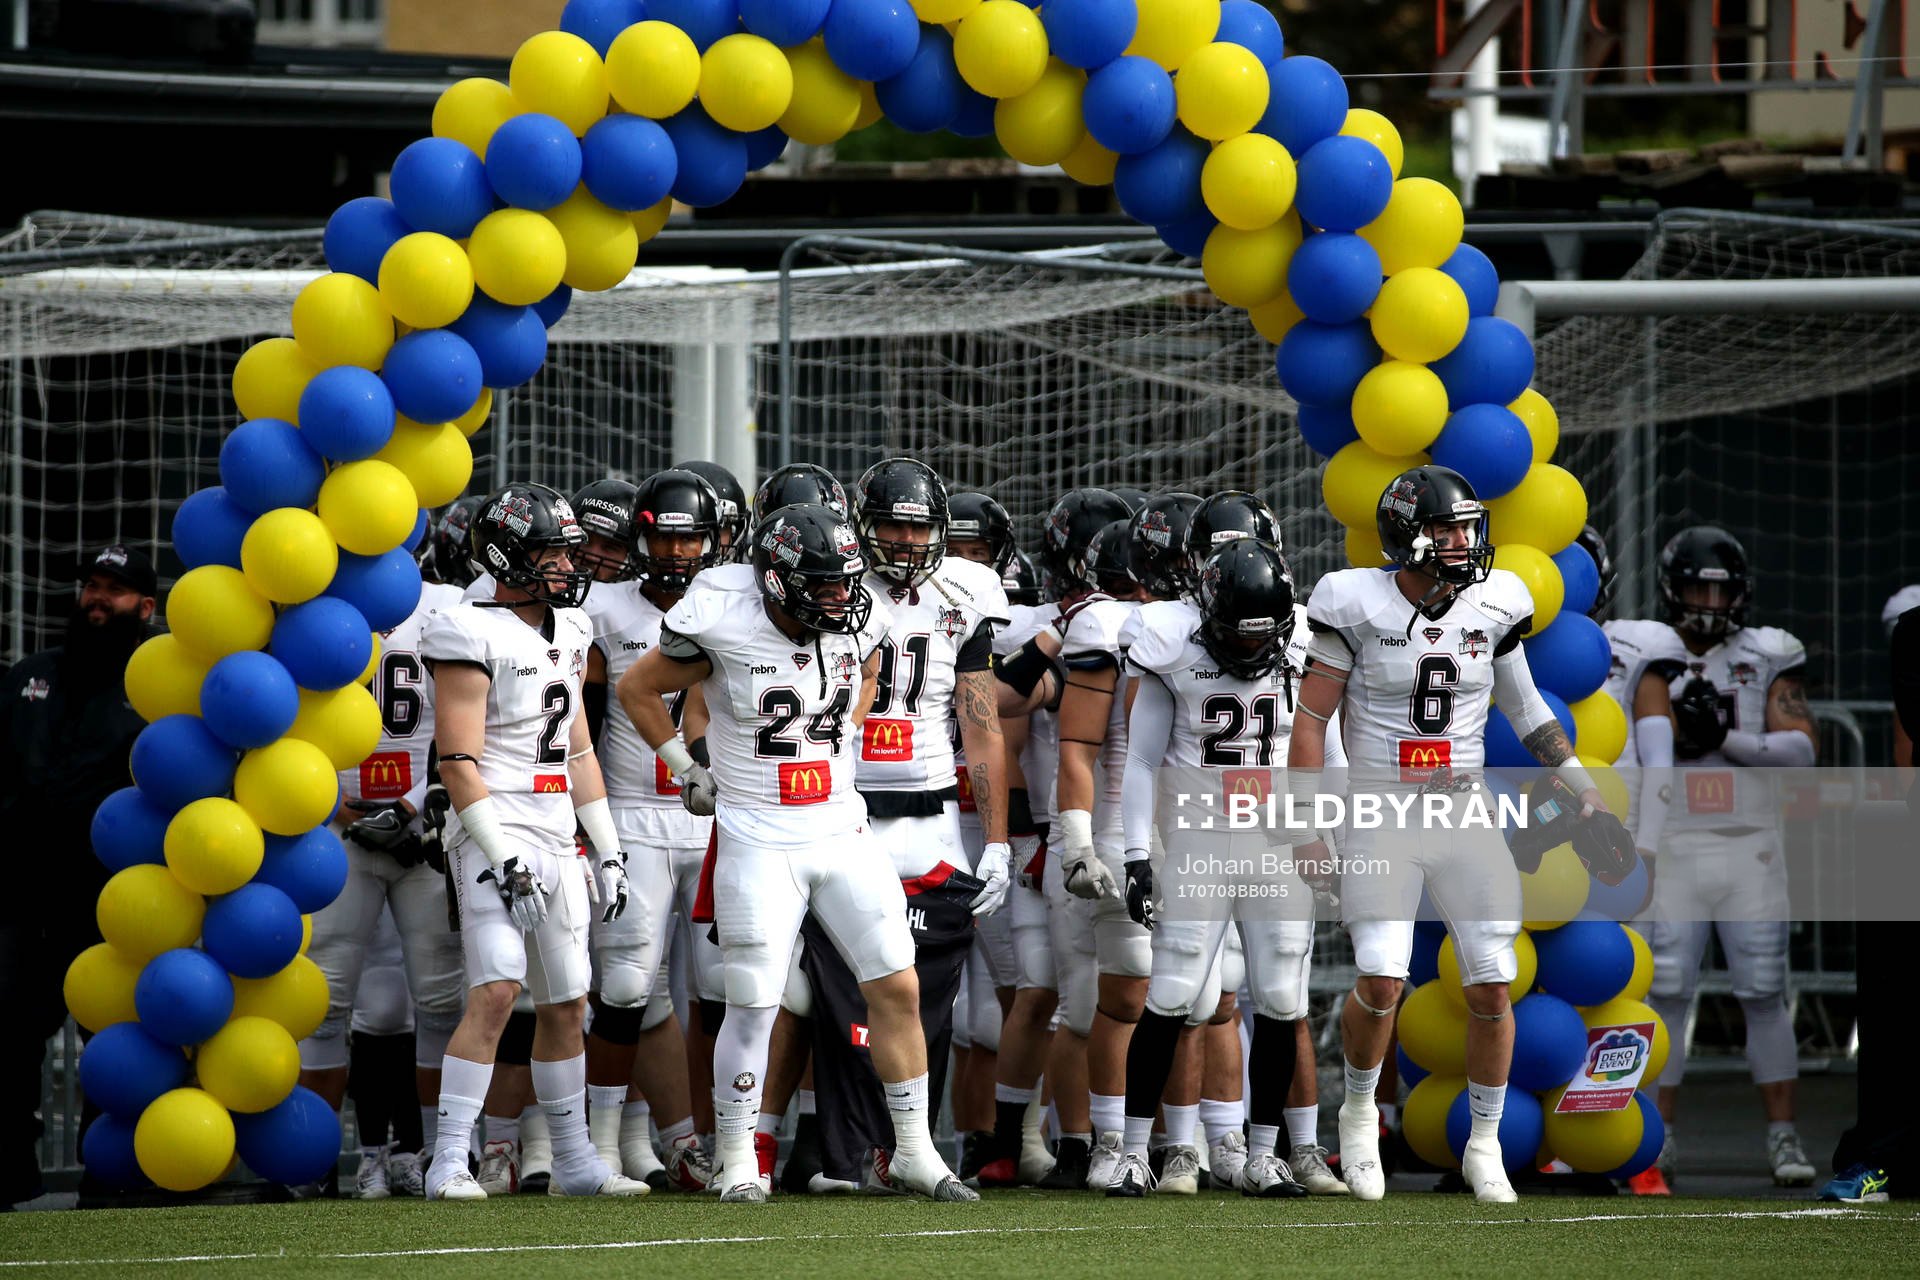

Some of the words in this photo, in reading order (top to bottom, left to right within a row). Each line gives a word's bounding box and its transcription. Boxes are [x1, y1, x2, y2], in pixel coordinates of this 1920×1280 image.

[665, 514, 687, 522] Riddell
[900, 504, 922, 513] Riddell
[370, 649, 423, 738] 6
[535, 679, 573, 766] 2
[754, 683, 853, 758] 24
[1200, 692, 1279, 768] 21
[1409, 652, 1461, 736] 6
[1599, 1059, 1631, 1070] EVENT
[1601, 1050, 1633, 1062] DEKO
